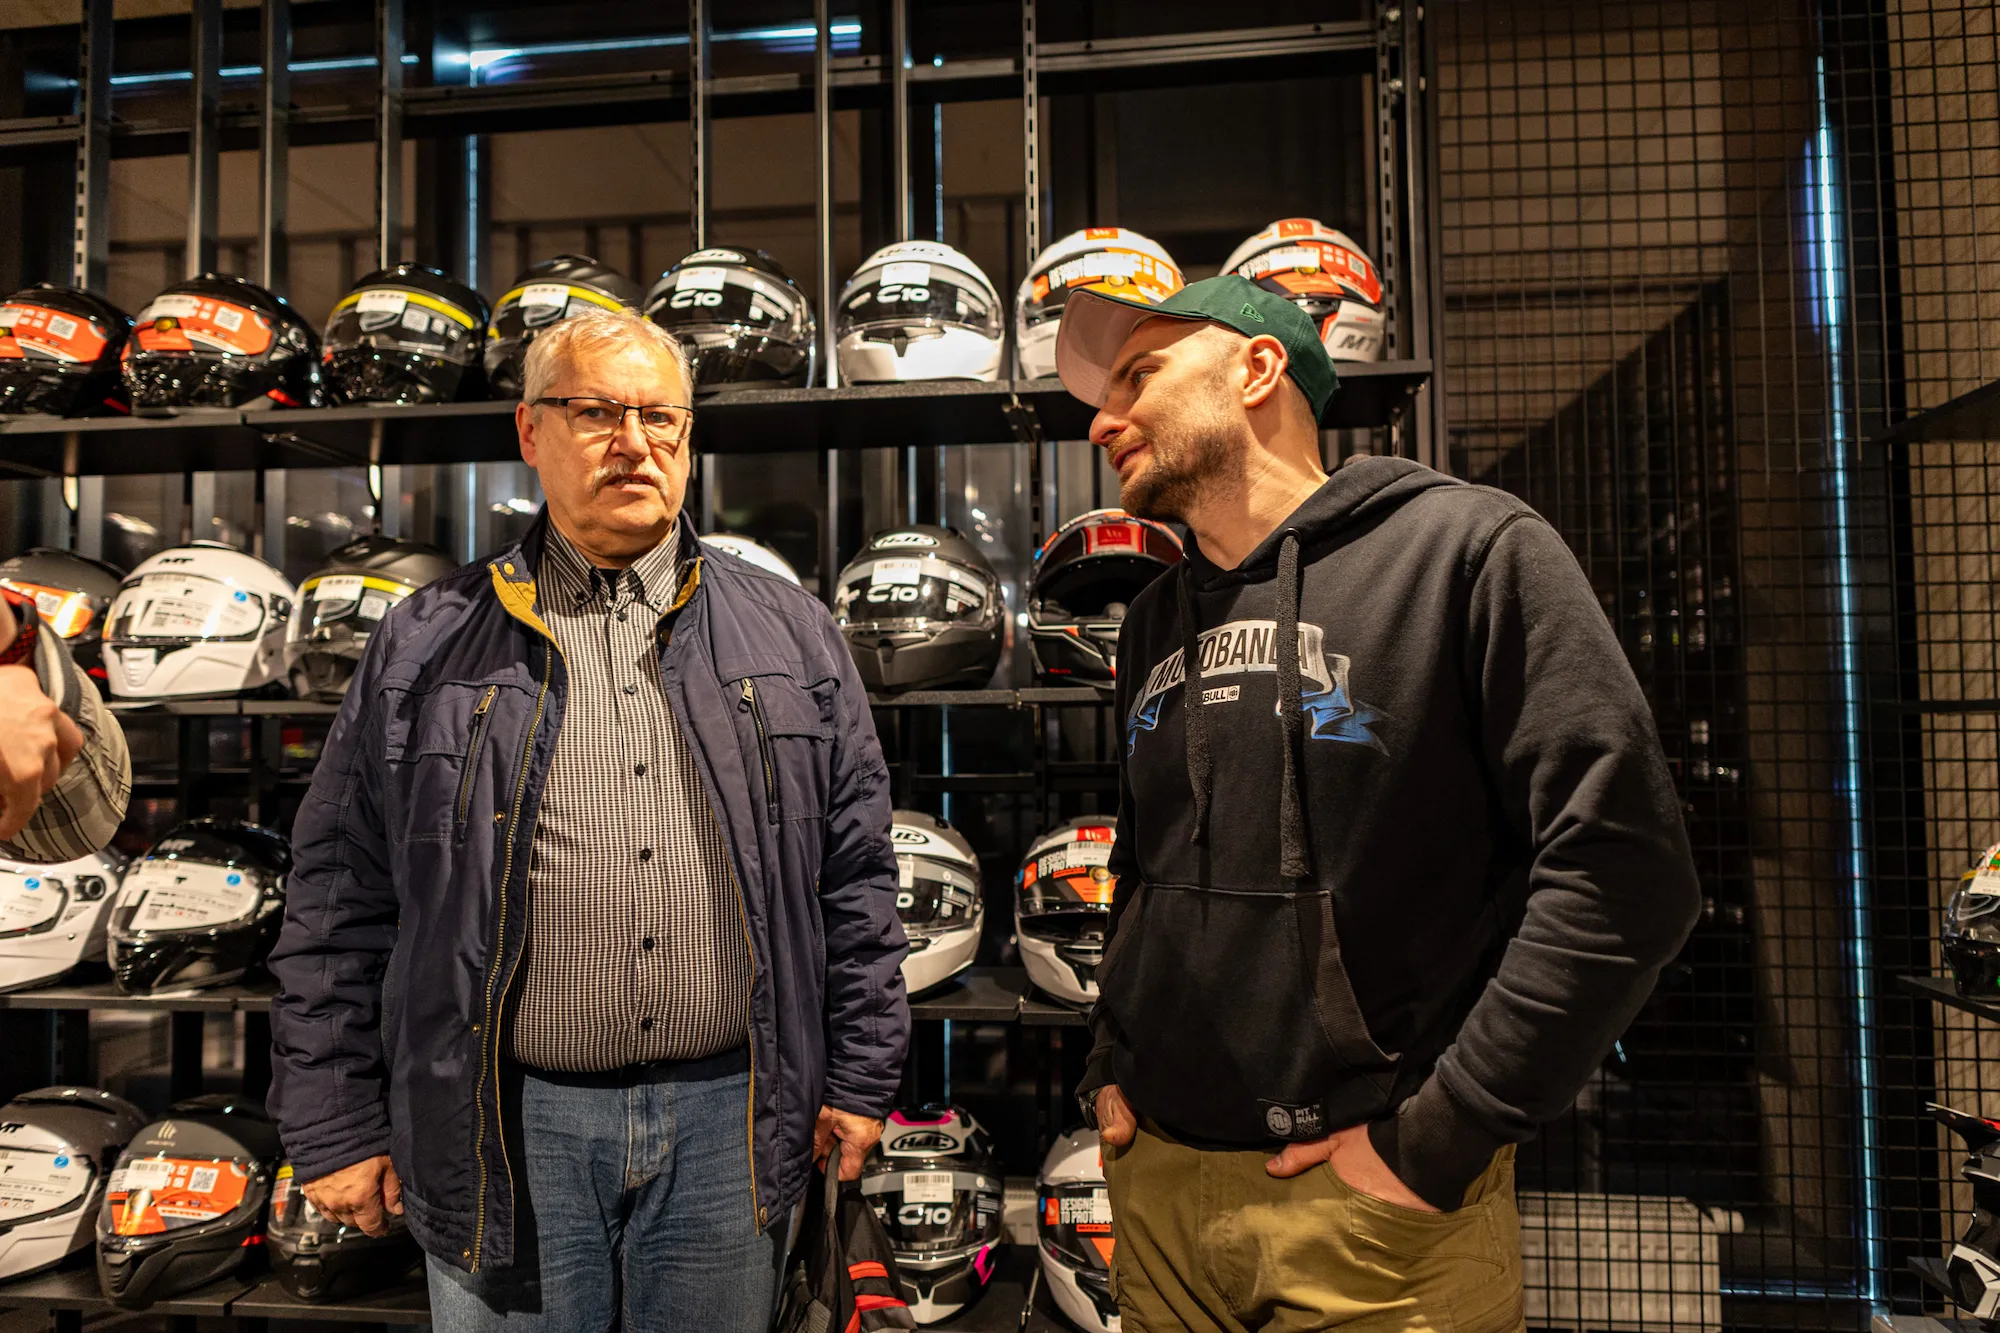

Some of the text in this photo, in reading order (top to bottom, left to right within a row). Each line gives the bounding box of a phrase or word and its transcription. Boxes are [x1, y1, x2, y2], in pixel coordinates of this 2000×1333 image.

[670, 289, 723, 309] C10
[877, 284, 930, 303] C10
[866, 583, 918, 603] C10
[1148, 627, 1308, 695] MOOBANA
[899, 1134, 950, 1149] HJC
[1061, 1198, 1094, 1210] DESIGNE
[898, 1204, 952, 1225] C10
